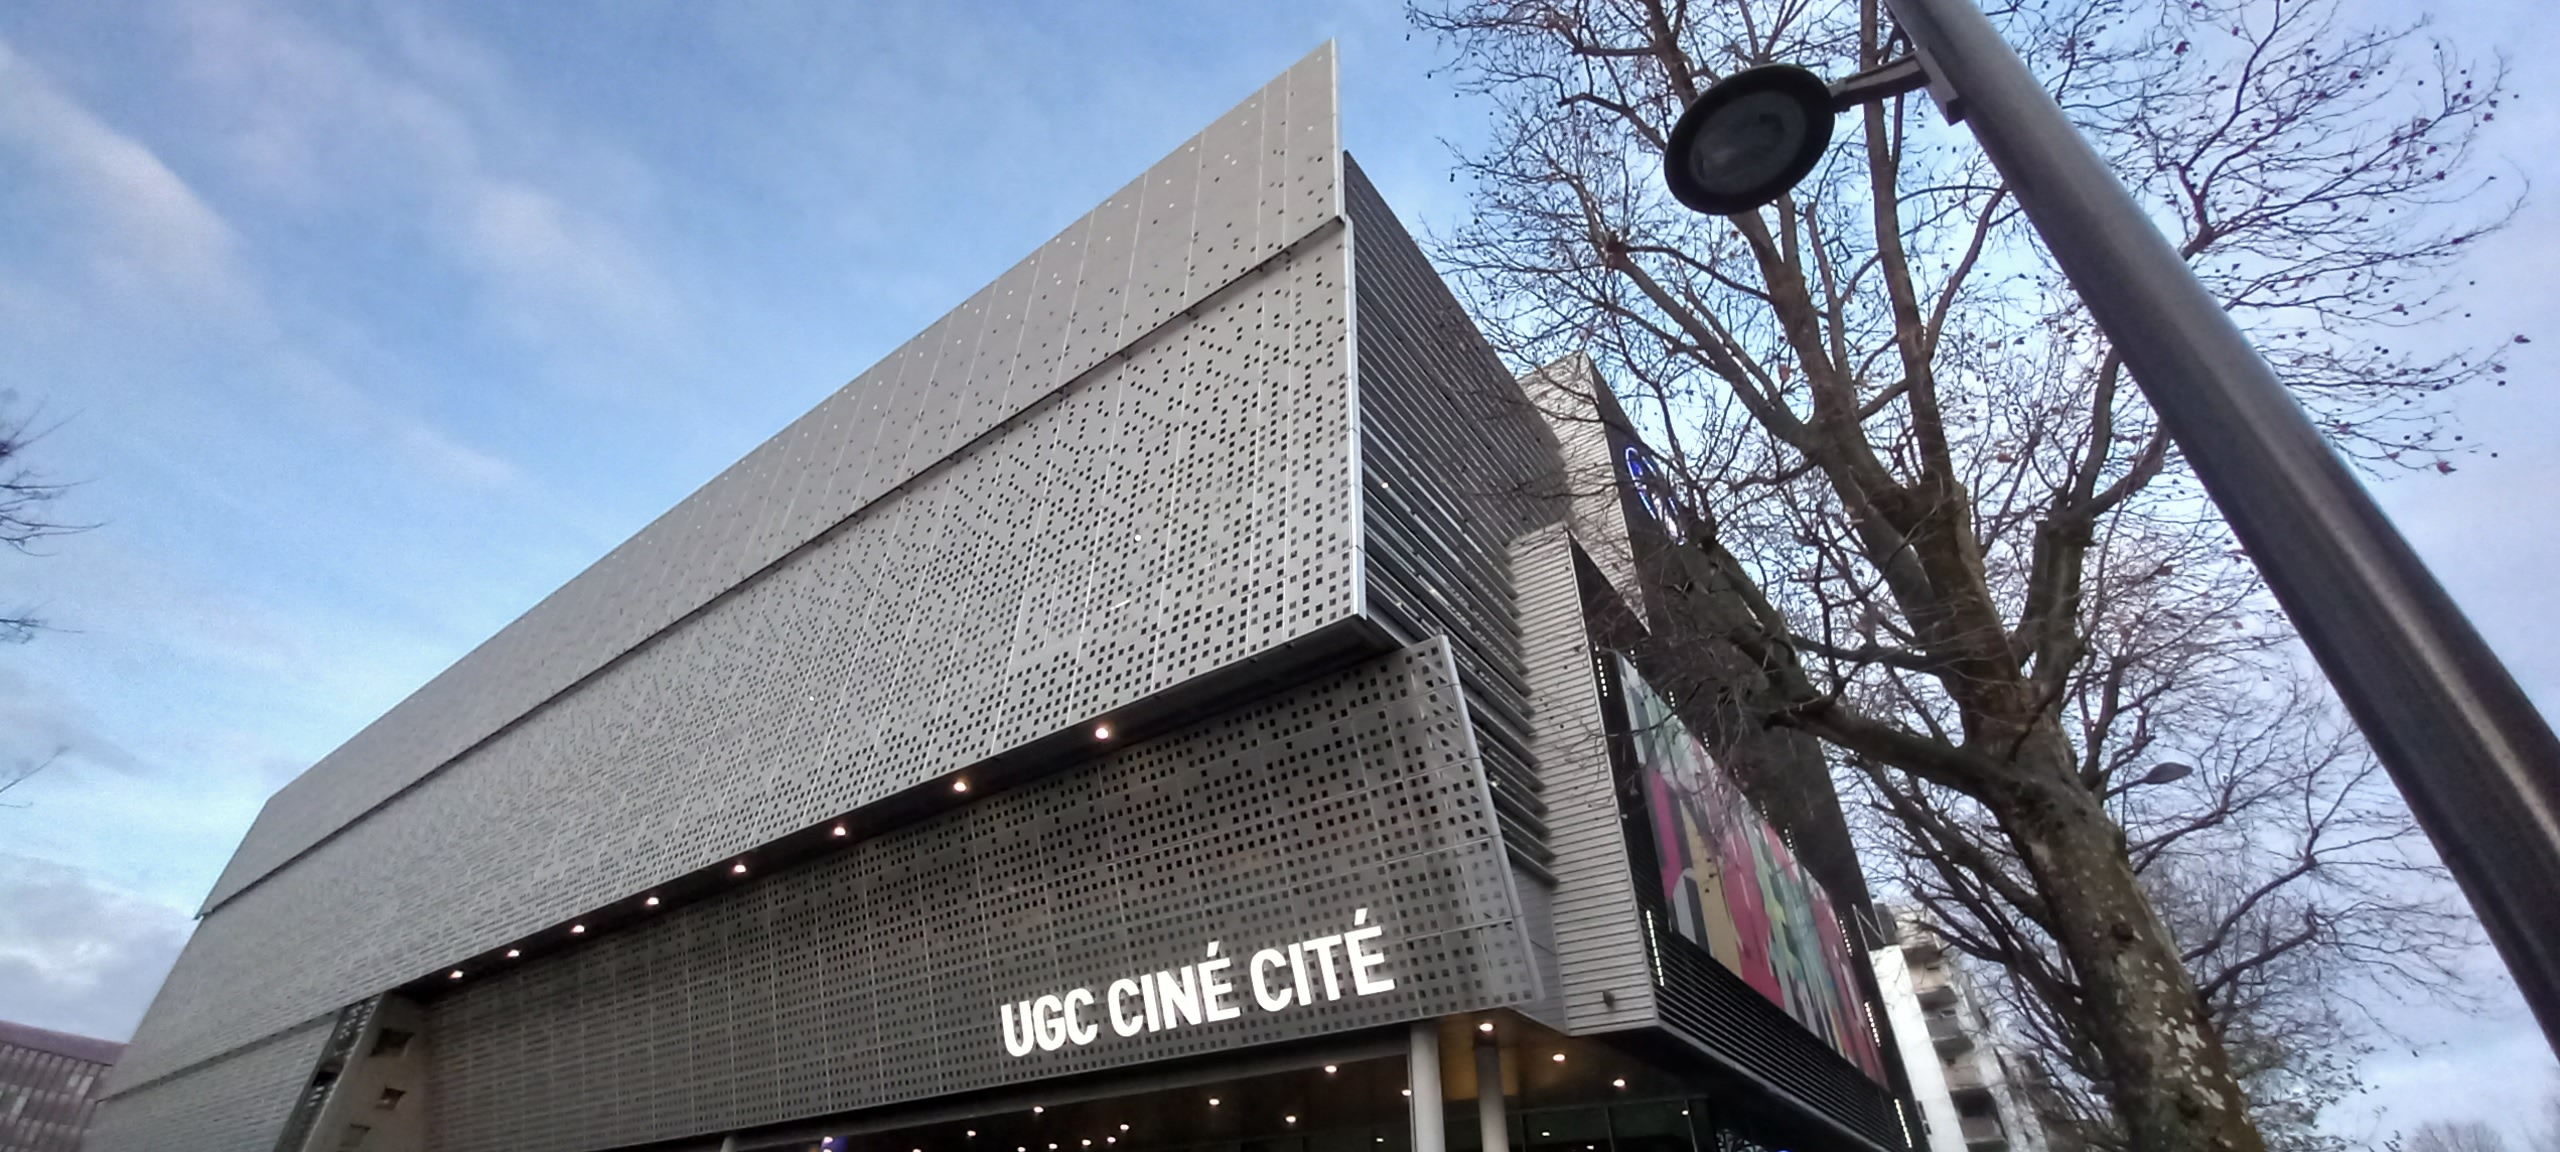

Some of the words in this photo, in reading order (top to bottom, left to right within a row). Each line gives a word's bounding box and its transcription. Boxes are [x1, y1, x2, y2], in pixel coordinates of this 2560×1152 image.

[1000, 987, 1099, 1058] UGC
[1107, 940, 1241, 1037] CINÉ
[1249, 907, 1396, 1012] CITÉ
